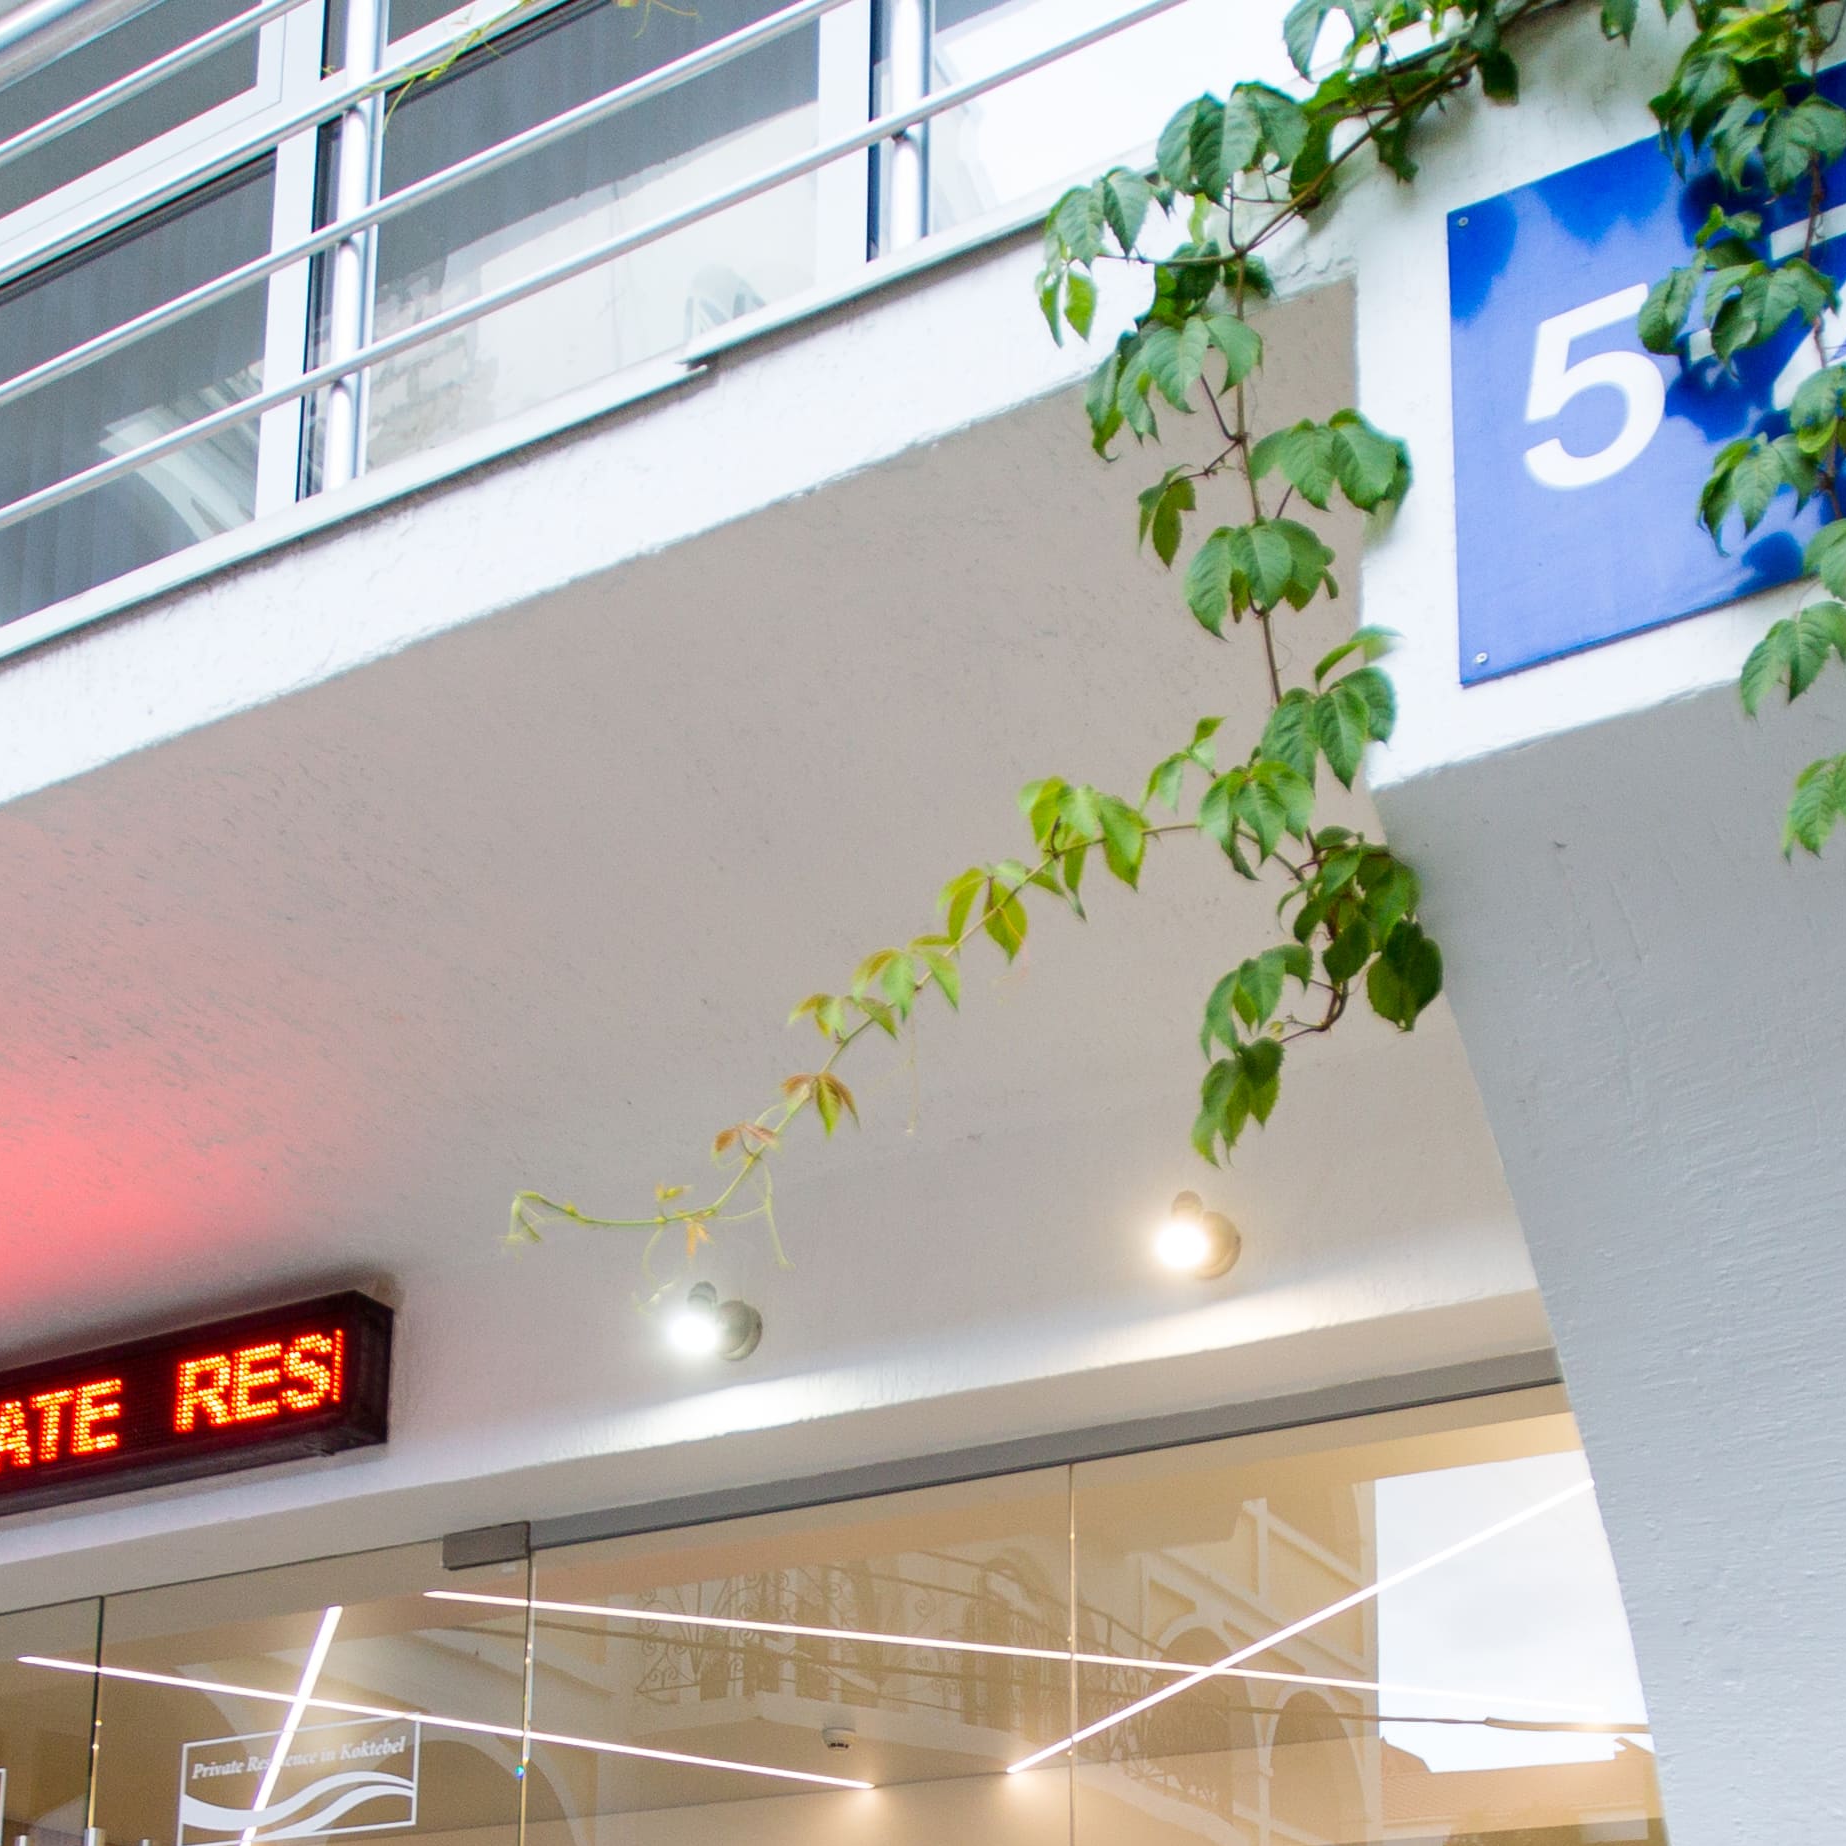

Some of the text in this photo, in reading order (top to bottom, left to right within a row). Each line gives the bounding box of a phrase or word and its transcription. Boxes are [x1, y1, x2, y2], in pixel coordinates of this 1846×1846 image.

[191, 1735, 406, 1779] Private Resence in Koktebel
